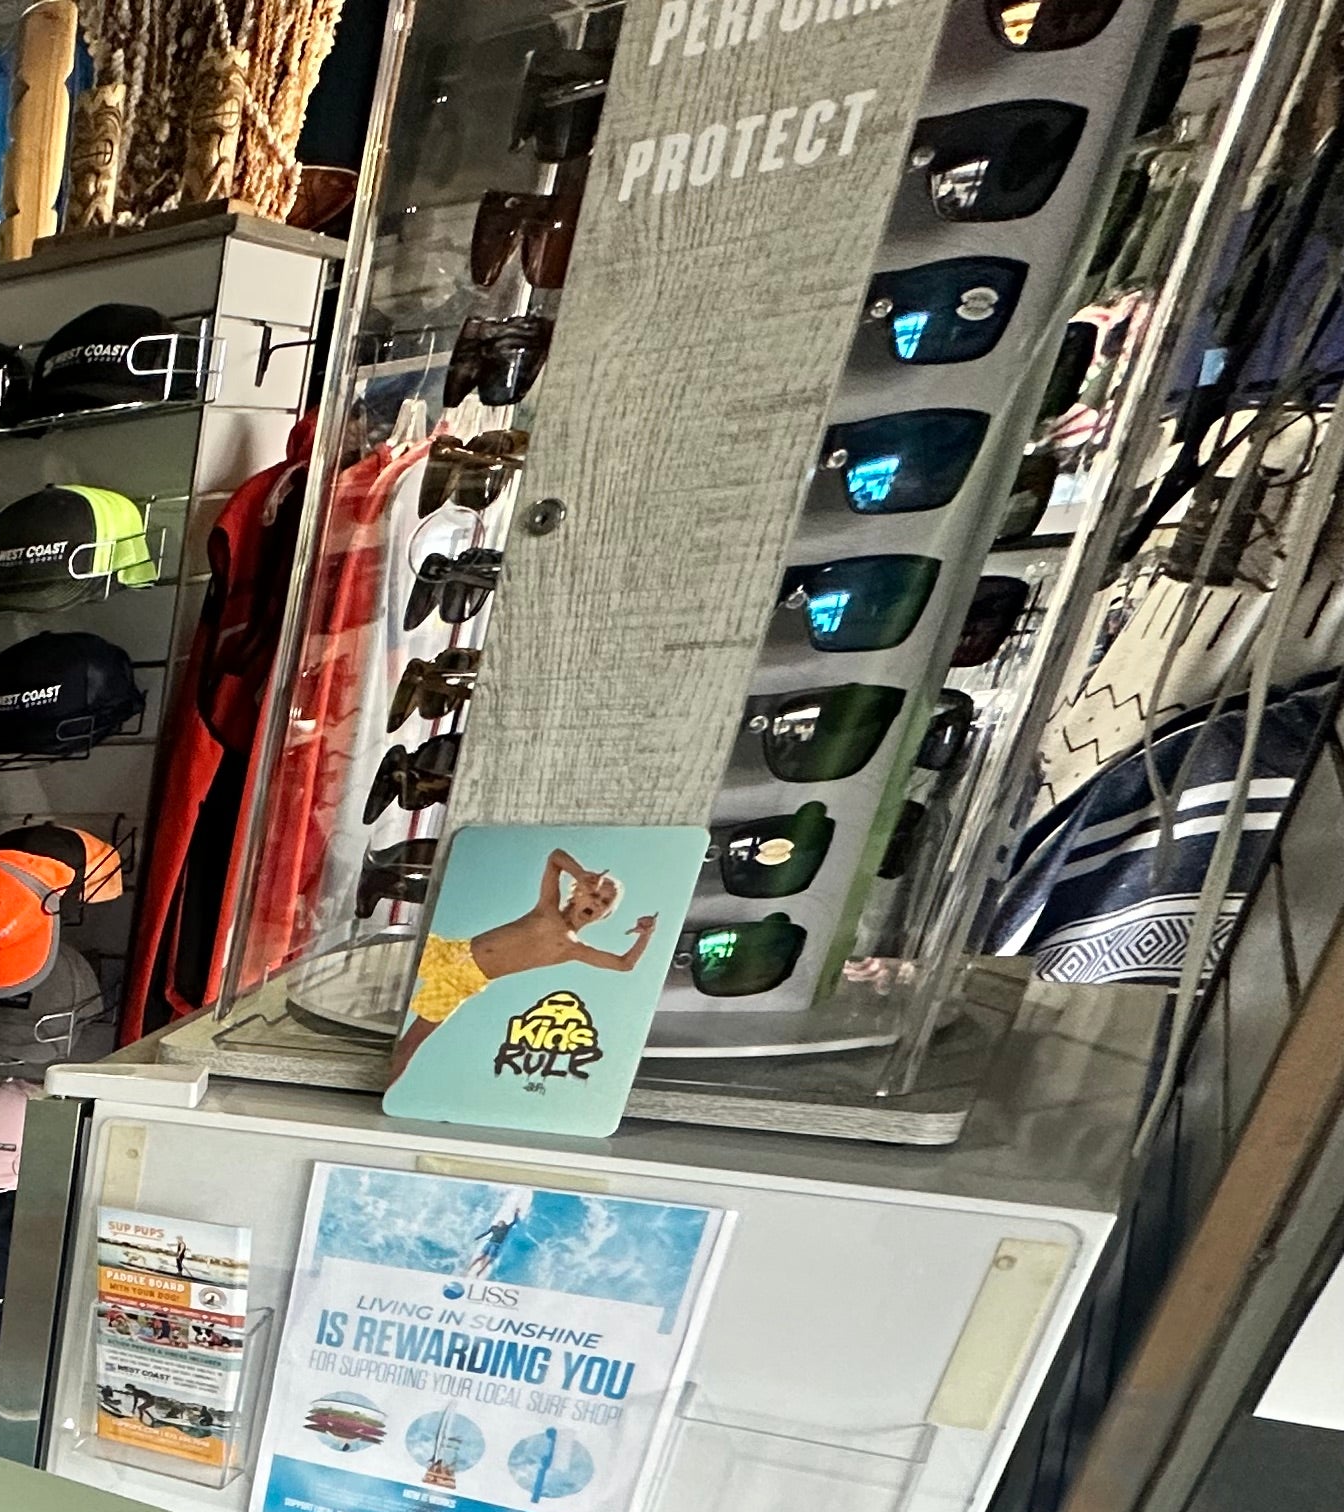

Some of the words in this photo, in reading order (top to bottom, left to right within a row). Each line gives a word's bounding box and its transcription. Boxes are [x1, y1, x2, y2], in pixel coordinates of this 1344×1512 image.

[649, 0, 899, 66] PERFO
[618, 88, 877, 202] PROTECT
[84, 344, 129, 358] COAST
[25, 541, 69, 559] COAST
[21, 684, 62, 703] COAST
[507, 1016, 597, 1053] Kids
[493, 1041, 604, 1080] RULE
[107, 1220, 132, 1234] SUP
[134, 1223, 166, 1239] PUPS
[105, 1270, 146, 1287] PADDLE
[148, 1277, 185, 1293] BOARD
[466, 1283, 521, 1308] LISS
[356, 1294, 433, 1322] LIVING
[438, 1308, 467, 1327] IN
[469, 1314, 604, 1350] SUNSHINE
[315, 1308, 349, 1349] IS
[352, 1315, 552, 1386] REWARDING
[561, 1351, 637, 1401] YOU
[309, 1350, 337, 1373] FOR
[338, 1354, 428, 1391] SUPPORTING
[432, 1371, 473, 1399] YOUR
[474, 1381, 523, 1410] LOCAL
[528, 1390, 571, 1418] SURF
[571, 1399, 624, 1428] SHOP!
